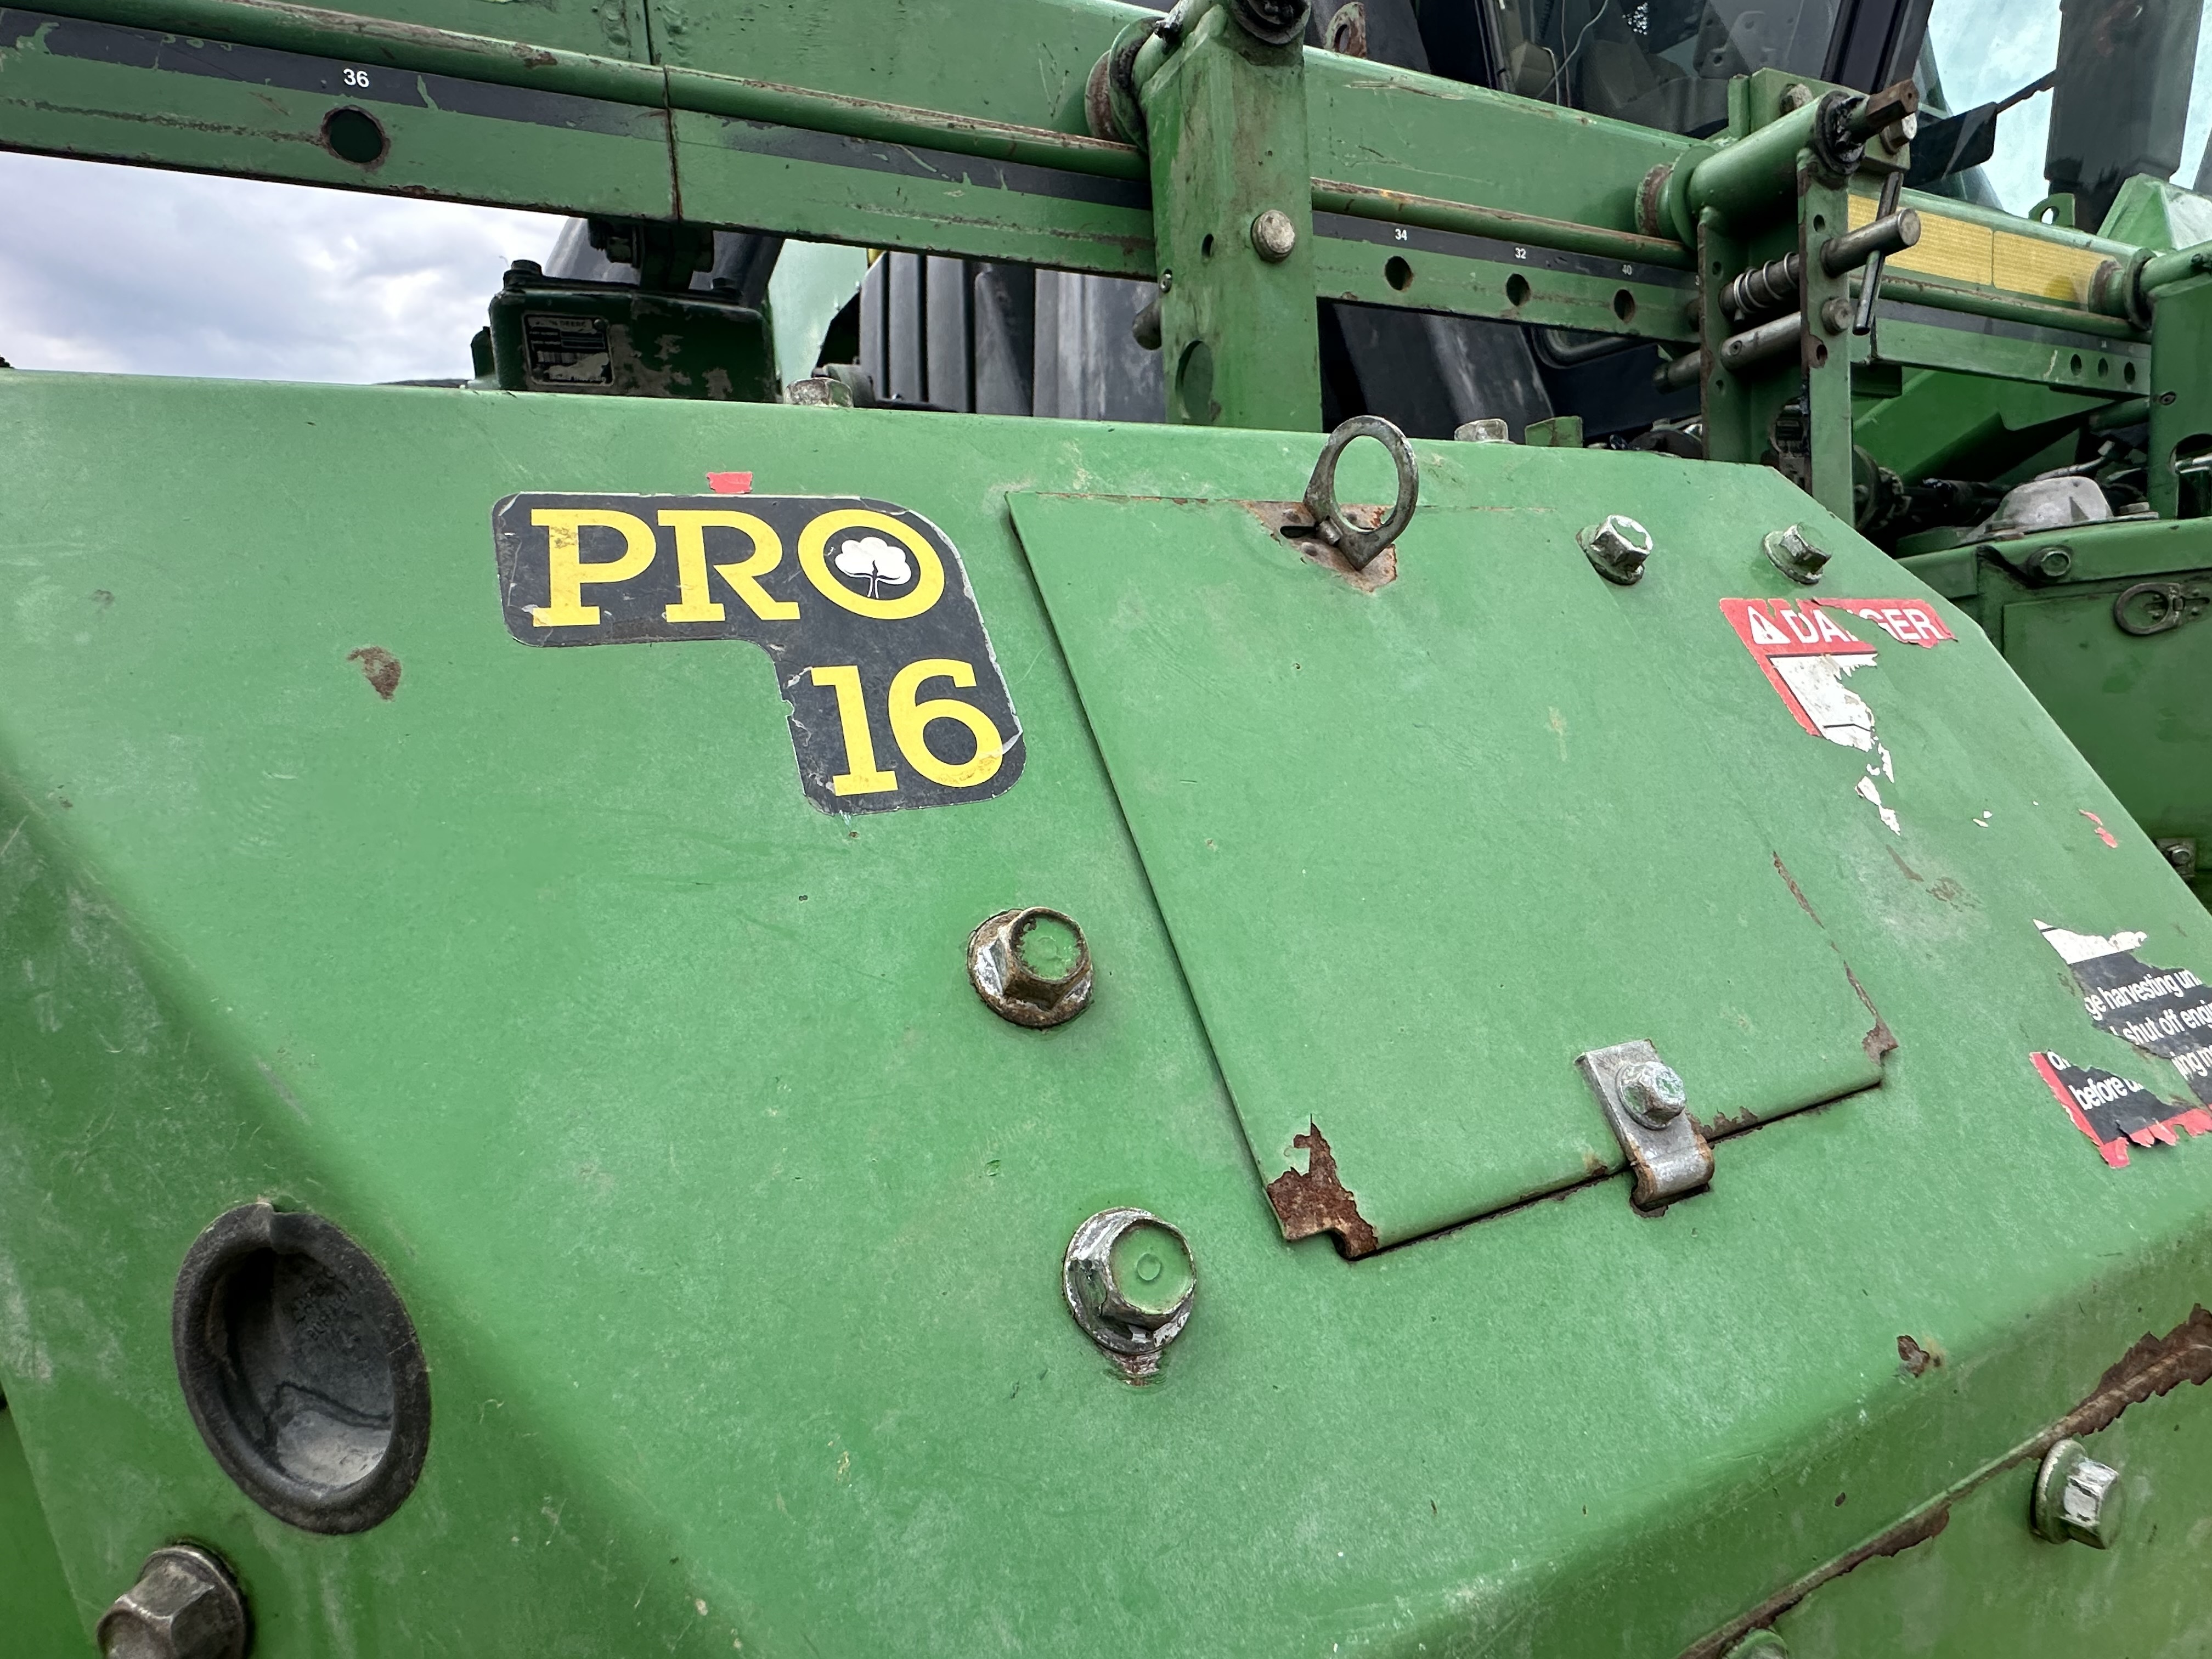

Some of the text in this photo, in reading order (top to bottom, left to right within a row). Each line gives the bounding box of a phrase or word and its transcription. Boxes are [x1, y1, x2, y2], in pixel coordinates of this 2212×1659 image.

[343, 68, 370, 88] 36
[1395, 228, 1407, 241] 34
[1515, 247, 1526, 259] 32
[531, 509, 945, 628] PRO
[811, 658, 1004, 797] 16
[2097, 973, 2184, 1009] harvesting
[2174, 969, 2204, 988] un
[2122, 999, 2212, 1046] shut off engi
[2068, 1076, 2128, 1110] before
